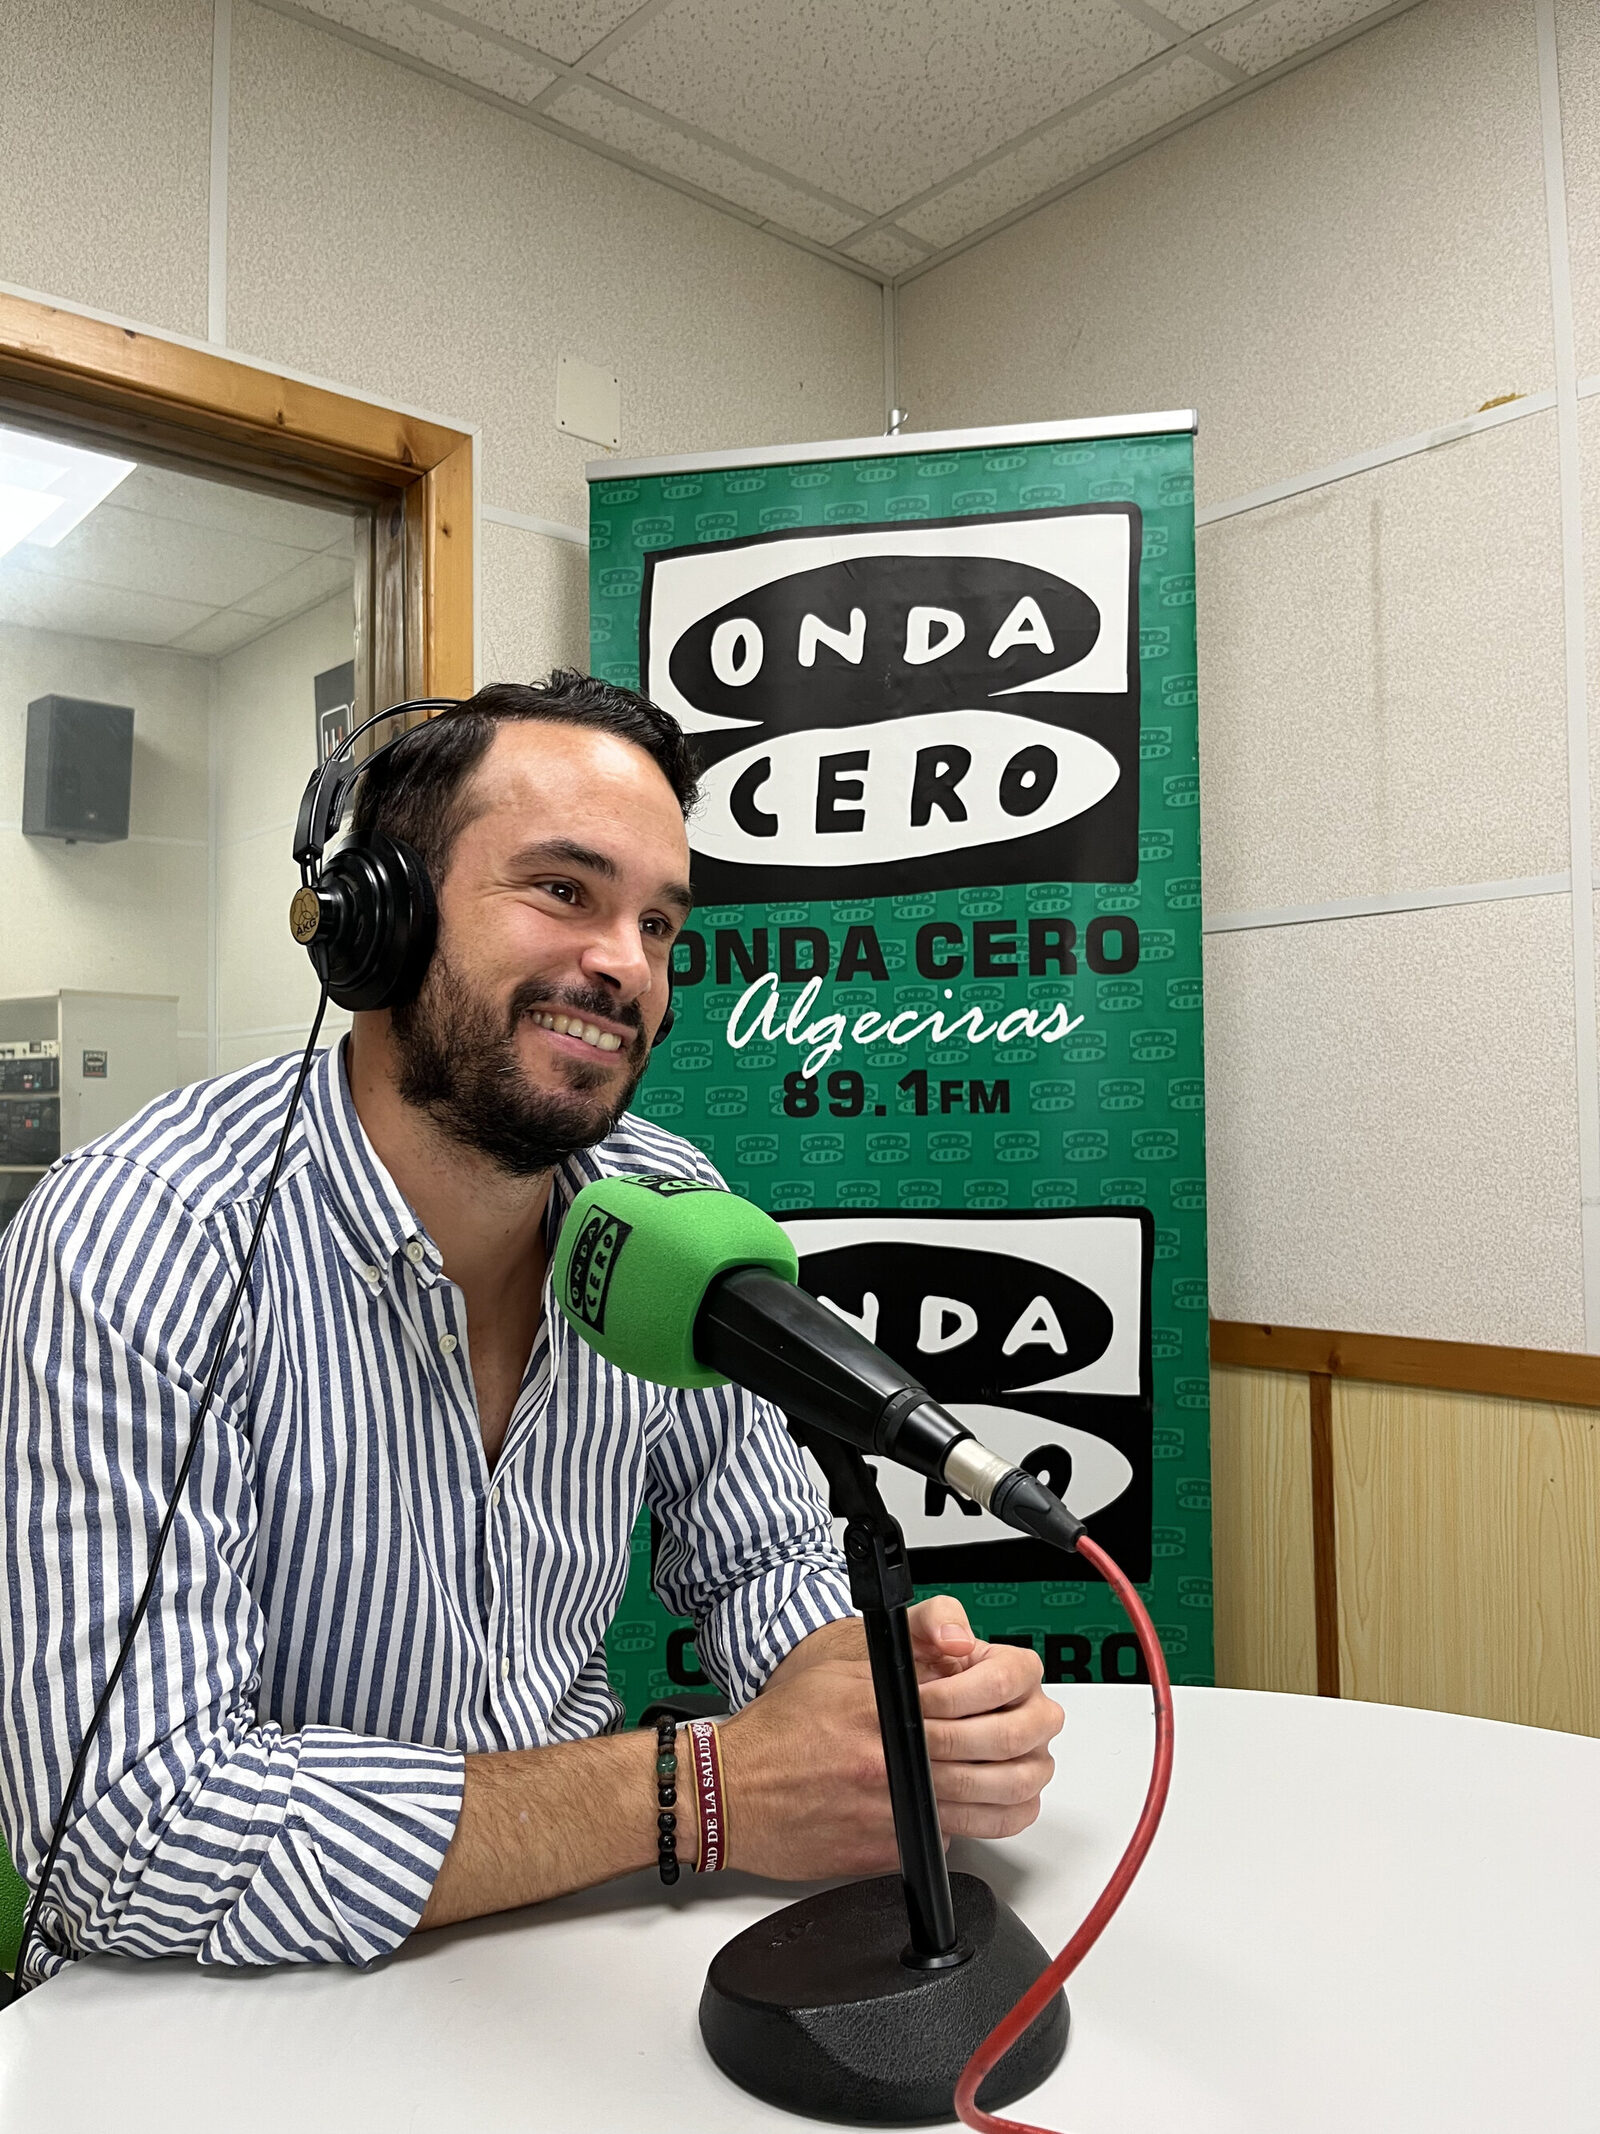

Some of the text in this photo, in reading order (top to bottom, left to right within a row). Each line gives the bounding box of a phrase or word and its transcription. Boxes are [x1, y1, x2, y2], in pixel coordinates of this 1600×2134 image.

[710, 596, 1054, 686] ONDA
[730, 744, 1057, 836] CERO
[297, 918, 316, 936] AKG
[916, 915, 1139, 979] CERO
[727, 972, 1084, 1079] Algeciras
[572, 1226, 599, 1299] ONDA
[587, 1234, 613, 1307] CERO
[699, 1737, 715, 1788] SALUD
[704, 1791, 718, 1816] LA
[706, 1818, 718, 1843] DE
